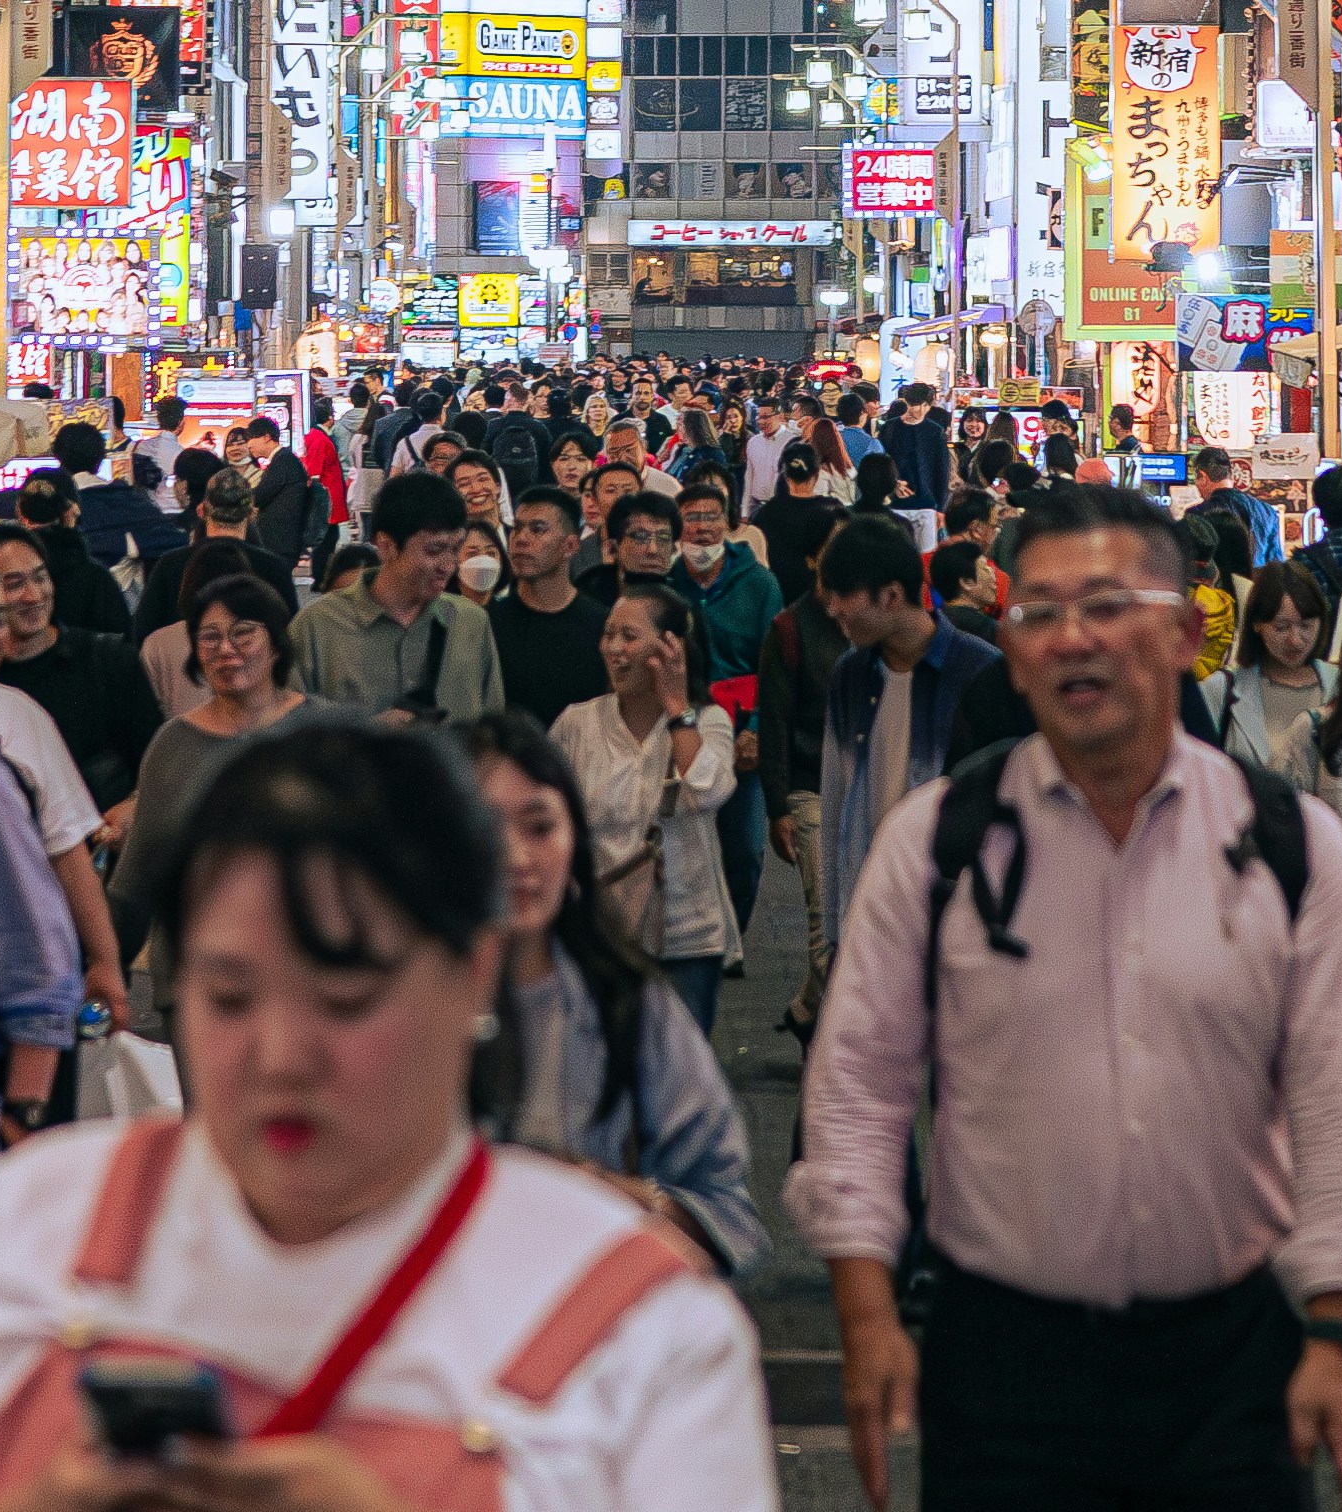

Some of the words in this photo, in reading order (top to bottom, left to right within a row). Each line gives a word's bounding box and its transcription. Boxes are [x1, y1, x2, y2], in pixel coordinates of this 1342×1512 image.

[1128, 39, 1190, 72] 新宿
[1151, 71, 1170, 89] の
[11, 80, 127, 148] 湖南
[468, 81, 585, 121] SAUNA
[856, 152, 934, 181] 24時間
[1174, 98, 1191, 208] 九州のうまかもん
[1126, 94, 1174, 244] まっちゃん
[856, 181, 934, 208] 営業中
[1089, 287, 1138, 302] ONLINE
[1123, 307, 1141, 322] B1
